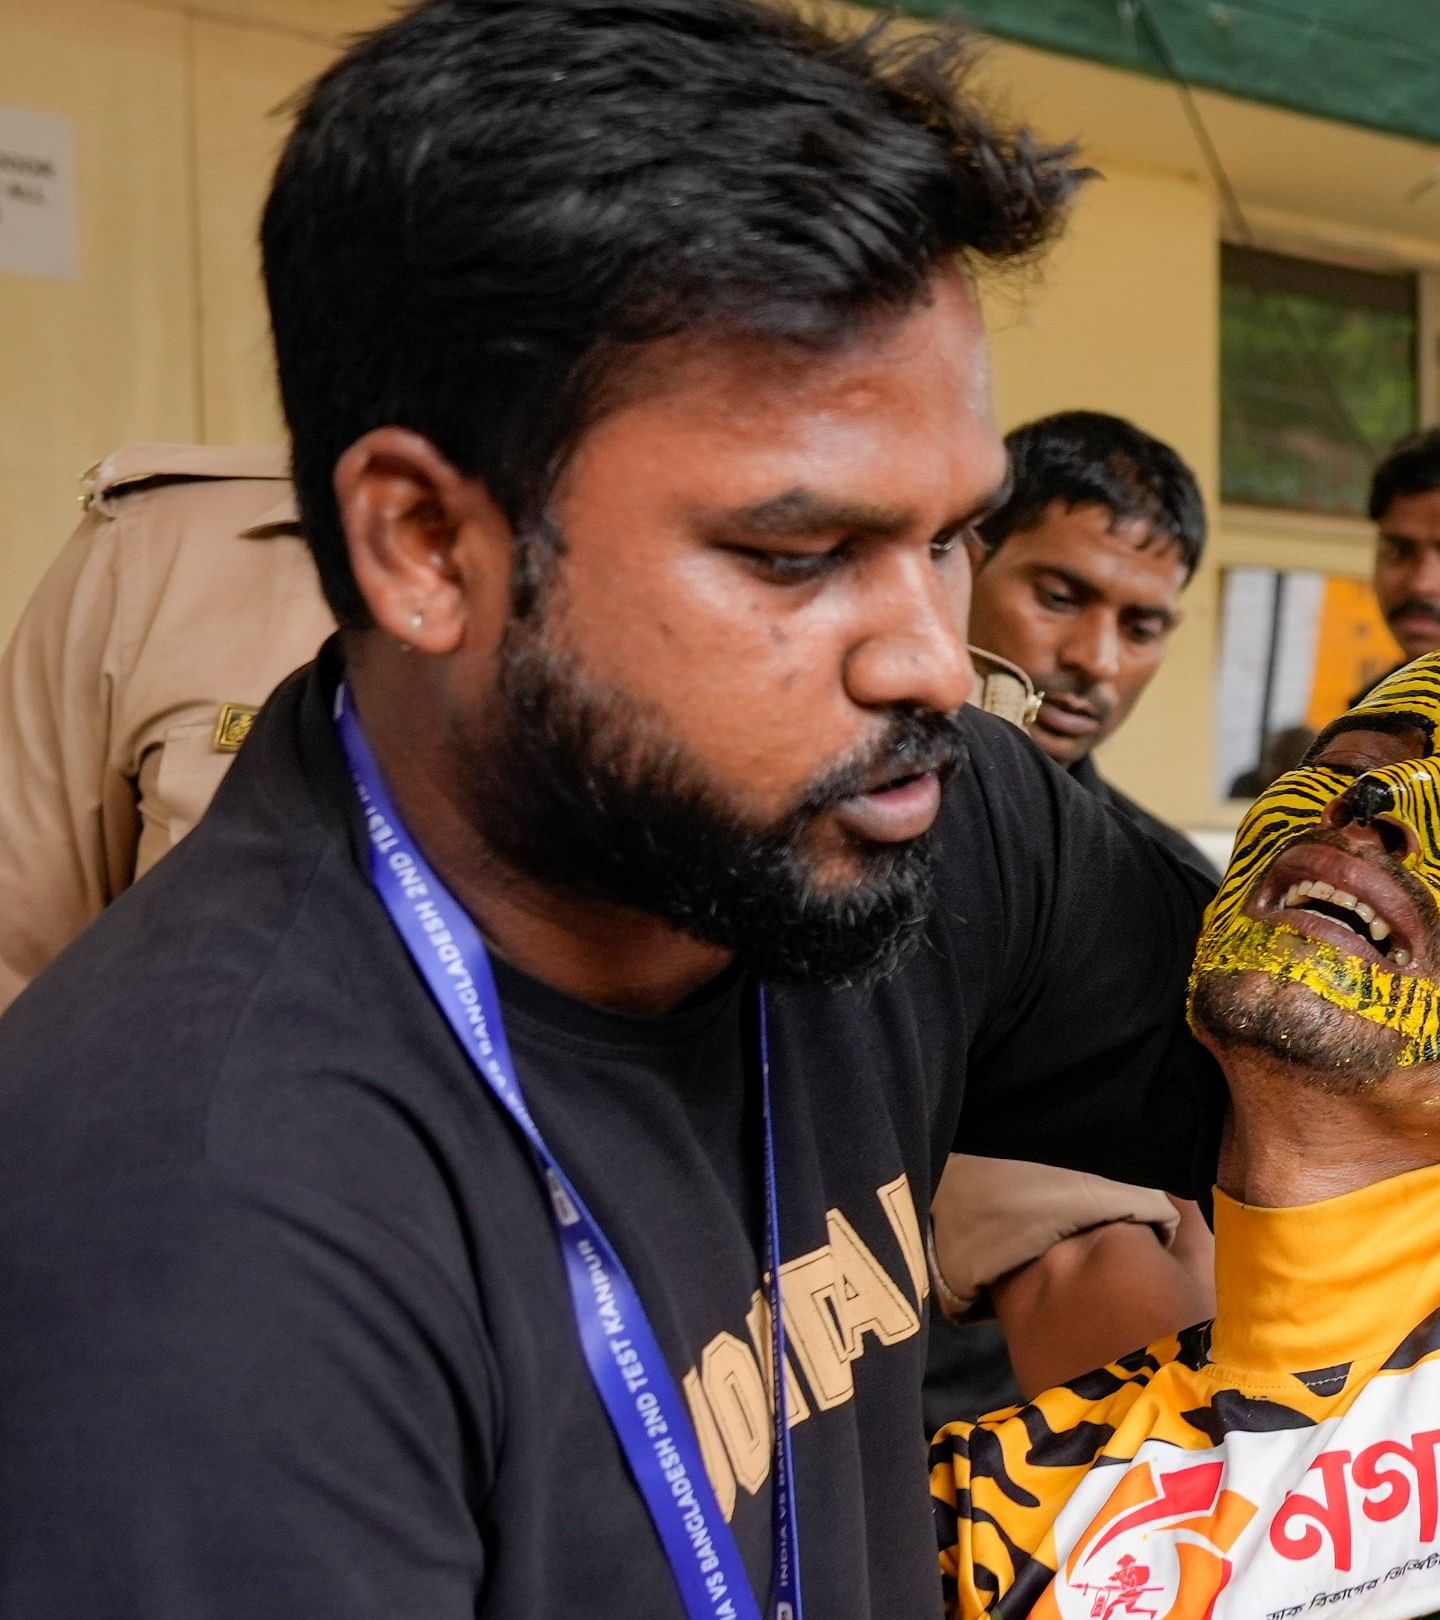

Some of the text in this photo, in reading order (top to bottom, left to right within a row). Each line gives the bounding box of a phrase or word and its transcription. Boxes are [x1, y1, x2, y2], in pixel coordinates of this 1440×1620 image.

[389, 850, 429, 899] 2ND
[414, 899, 494, 1057] BANGLADESH
[576, 1239, 625, 1336] KANPUR
[610, 1339, 649, 1394] TEST
[636, 1392, 668, 1438] 2ND
[653, 1437, 720, 1573] BANGLADESH
[779, 1525, 788, 1587] INDIA
[706, 1571, 728, 1602] VS
